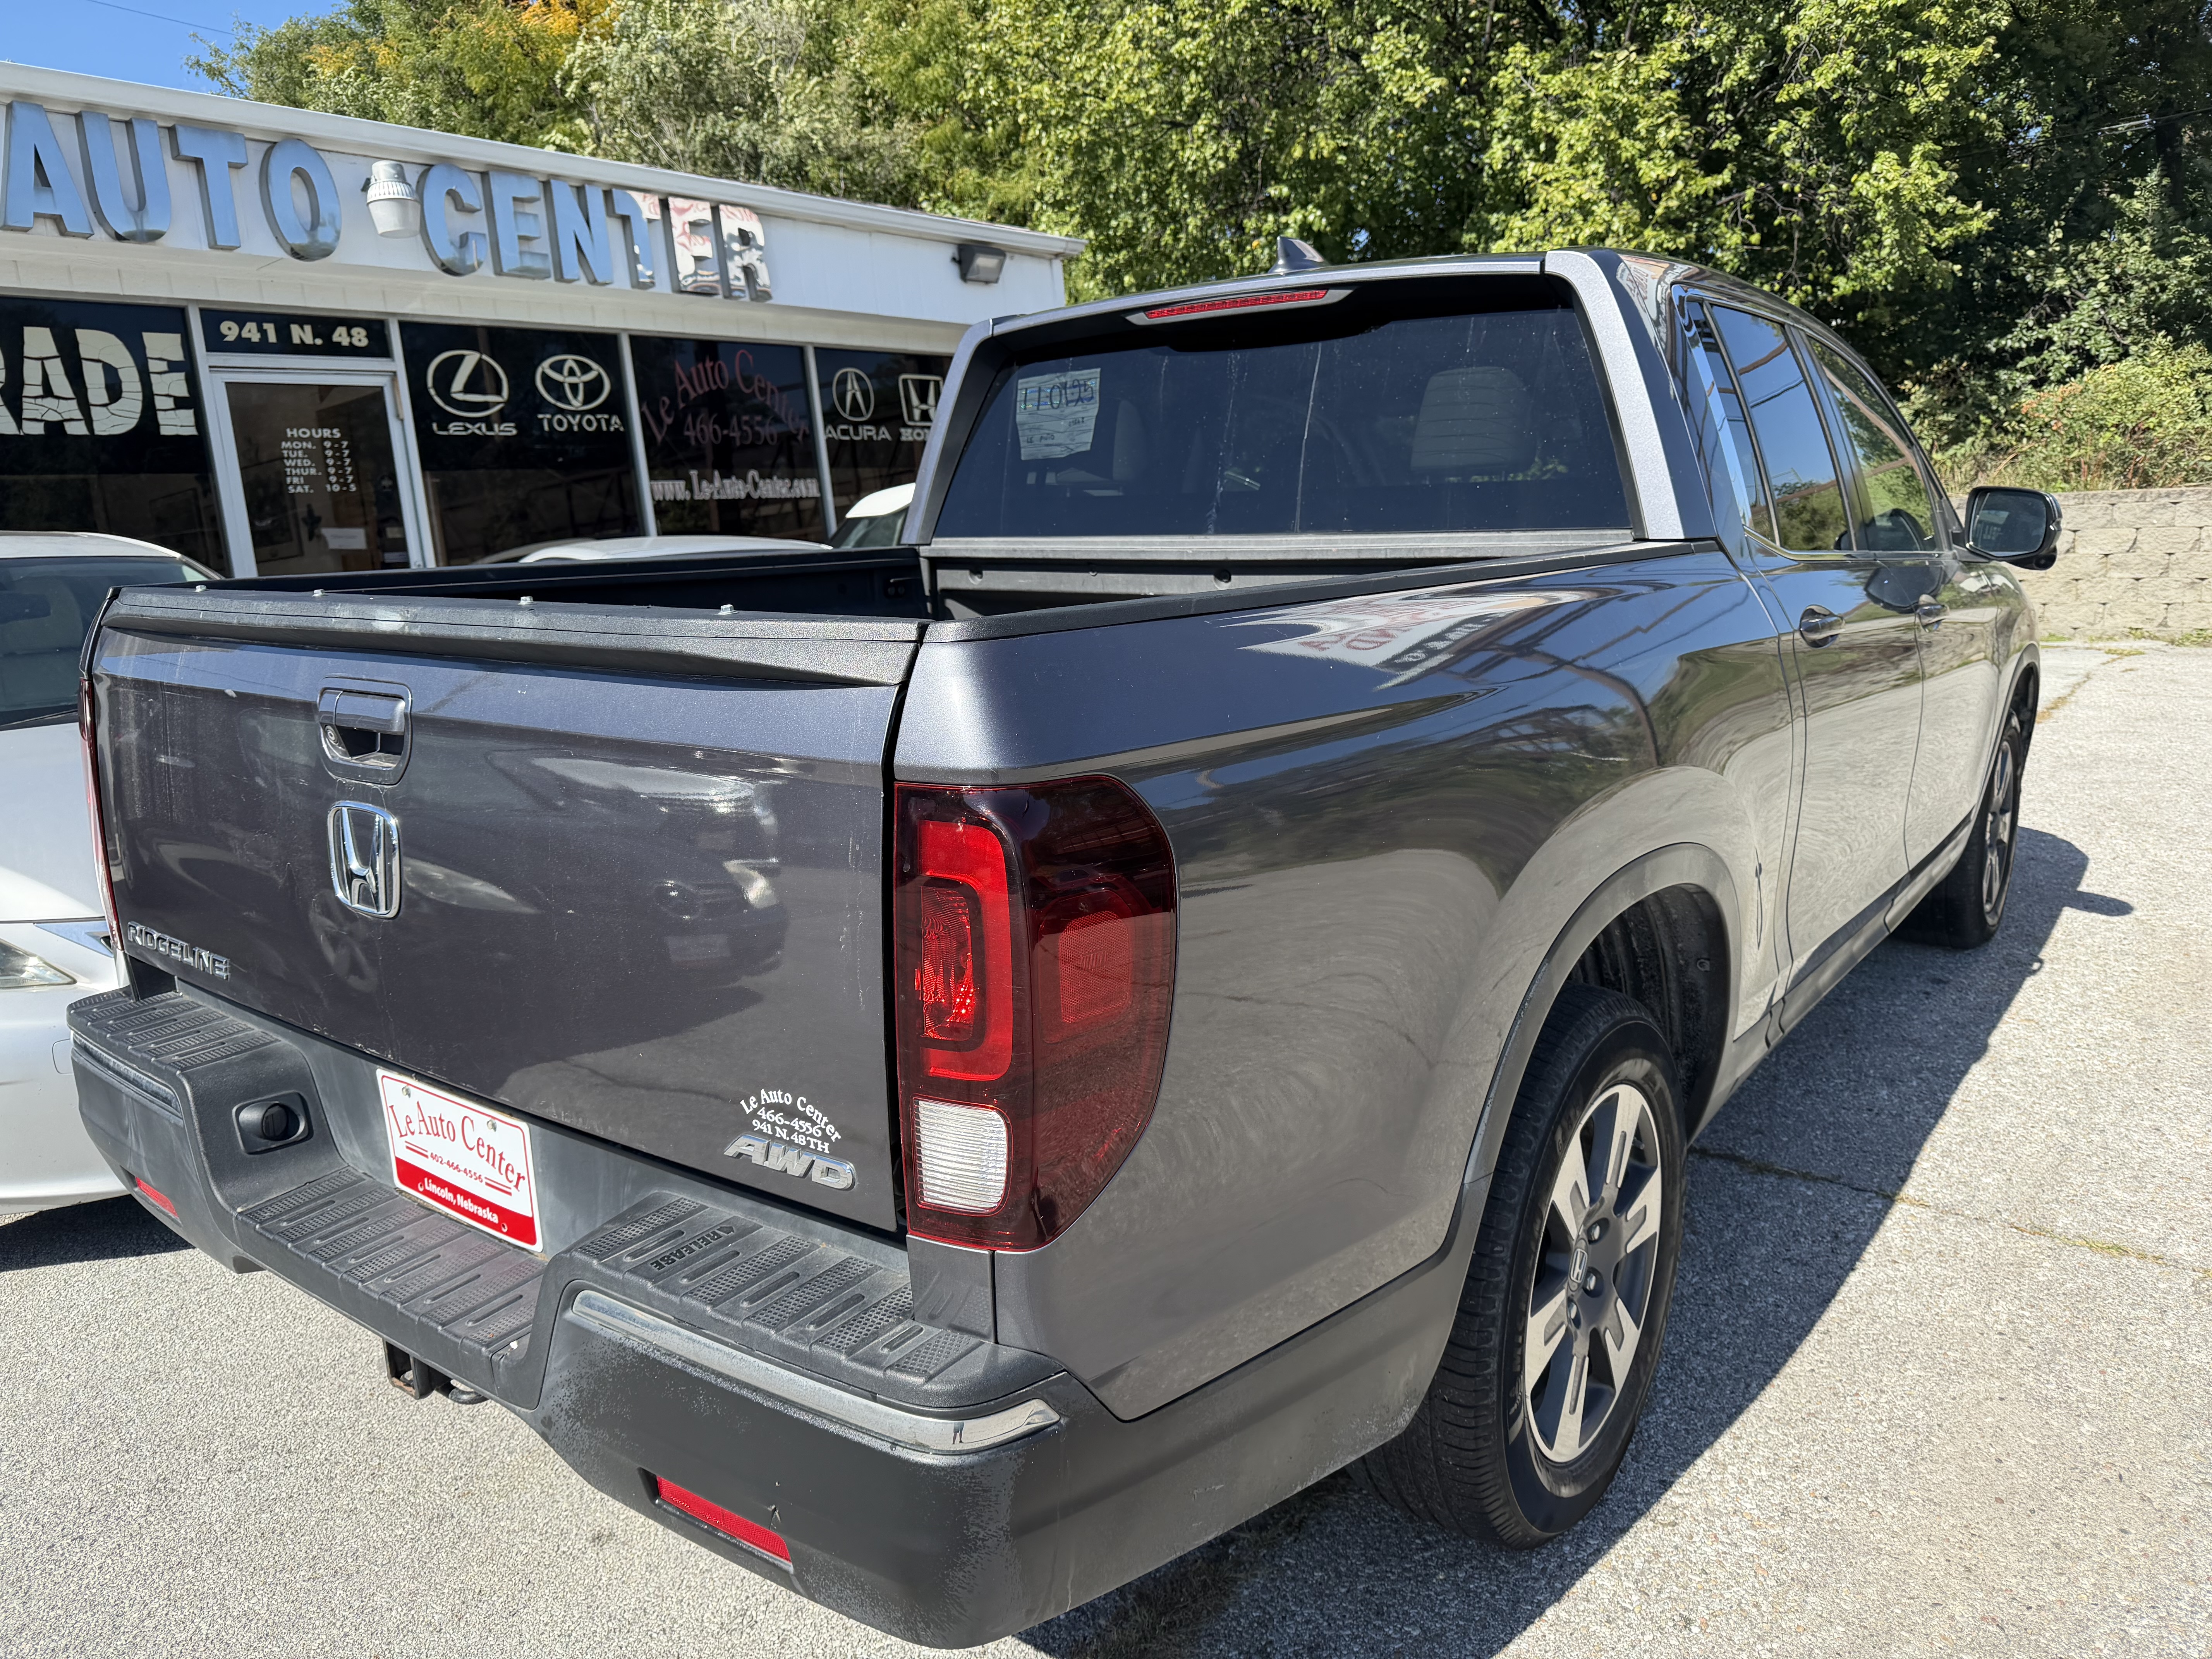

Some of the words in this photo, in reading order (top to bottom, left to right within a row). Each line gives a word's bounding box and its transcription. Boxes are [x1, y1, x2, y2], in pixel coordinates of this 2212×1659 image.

[1, 101, 342, 262] AUTO
[417, 163, 773, 302] CENTER
[220, 321, 277, 343] 941
[290, 324, 323, 345] N.
[332, 326, 369, 347] 48
[0, 326, 199, 435] ADE
[641, 396, 675, 445] Le
[675, 356, 729, 410] Auto
[735, 349, 810, 442] Center
[286, 428, 341, 438] HOURS
[432, 422, 518, 436] LEXUS
[537, 414, 625, 432] TOYOTA
[684, 413, 778, 447] 466-4556
[825, 424, 892, 441] ACURA
[281, 441, 316, 449] MON.
[282, 450, 308, 458] TUE.
[283, 459, 316, 467] WED.
[285, 467, 322, 476] THUR.
[286, 476, 304, 484] FRI
[288, 485, 314, 493] SAT.
[127, 921, 231, 981] RIDGELINE
[740, 1096, 758, 1115] Le
[761, 1089, 792, 1105] Auto
[797, 1096, 841, 1142] Center
[752, 1119, 773, 1135] 941
[775, 1126, 790, 1140] N.
[757, 1107, 822, 1137] 466-4556
[389, 1104, 415, 1138] Le
[416, 1101, 456, 1142] Auto
[461, 1116, 526, 1192] Center
[430, 1152, 483, 1183] 402-466-4556
[723, 1133, 857, 1191] AWD
[424, 1178, 457, 1205] Lincoln,
[457, 1194, 499, 1224] Nebraska
[650, 1230, 723, 1271] RELEASE
